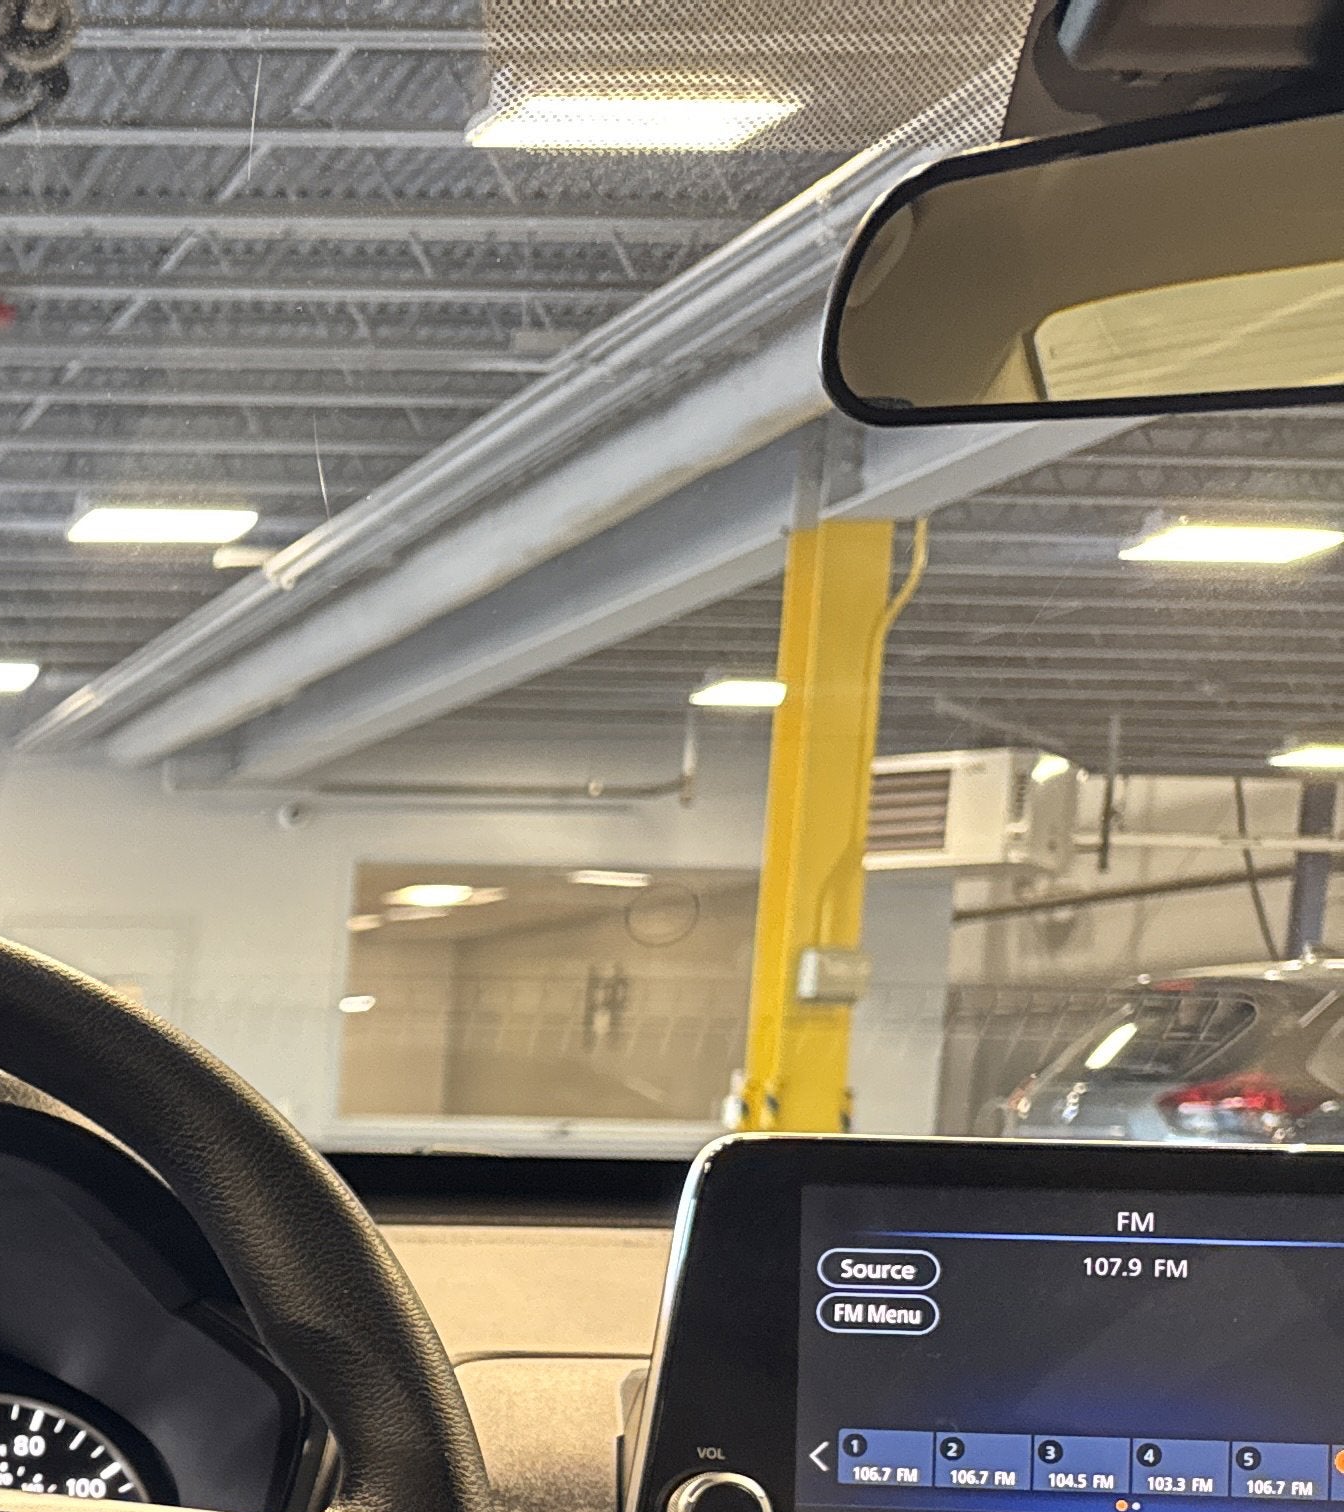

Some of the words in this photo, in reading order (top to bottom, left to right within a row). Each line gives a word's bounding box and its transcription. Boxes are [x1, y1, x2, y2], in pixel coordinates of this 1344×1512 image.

[1116, 1212, 1155, 1232] FM
[840, 1258, 916, 1280] Source
[1082, 1257, 1143, 1277] 107.9
[1154, 1259, 1188, 1279] FM
[833, 1304, 863, 1323] FM
[867, 1305, 922, 1325] Menu
[13, 1433, 46, 1457] 80
[696, 1447, 725, 1460] VOL
[850, 1439, 860, 1453] 1
[947, 1443, 958, 1456] 2
[1045, 1446, 1056, 1459] 3
[1143, 1449, 1154, 1462] 4
[1244, 1452, 1254, 1466] 5
[852, 1466, 892, 1482] 106.7
[896, 1468, 918, 1483] FM
[949, 1469, 988, 1485] 106.7
[994, 1472, 1016, 1486] FM
[1048, 1473, 1087, 1488] 104.5
[1092, 1475, 1114, 1489] FM
[66, 1477, 107, 1499] 100
[1147, 1476, 1186, 1492] 103.3
[1191, 1478, 1213, 1493] FM
[1246, 1479, 1285, 1495] 106.7
[1291, 1481, 1313, 1496] FM
